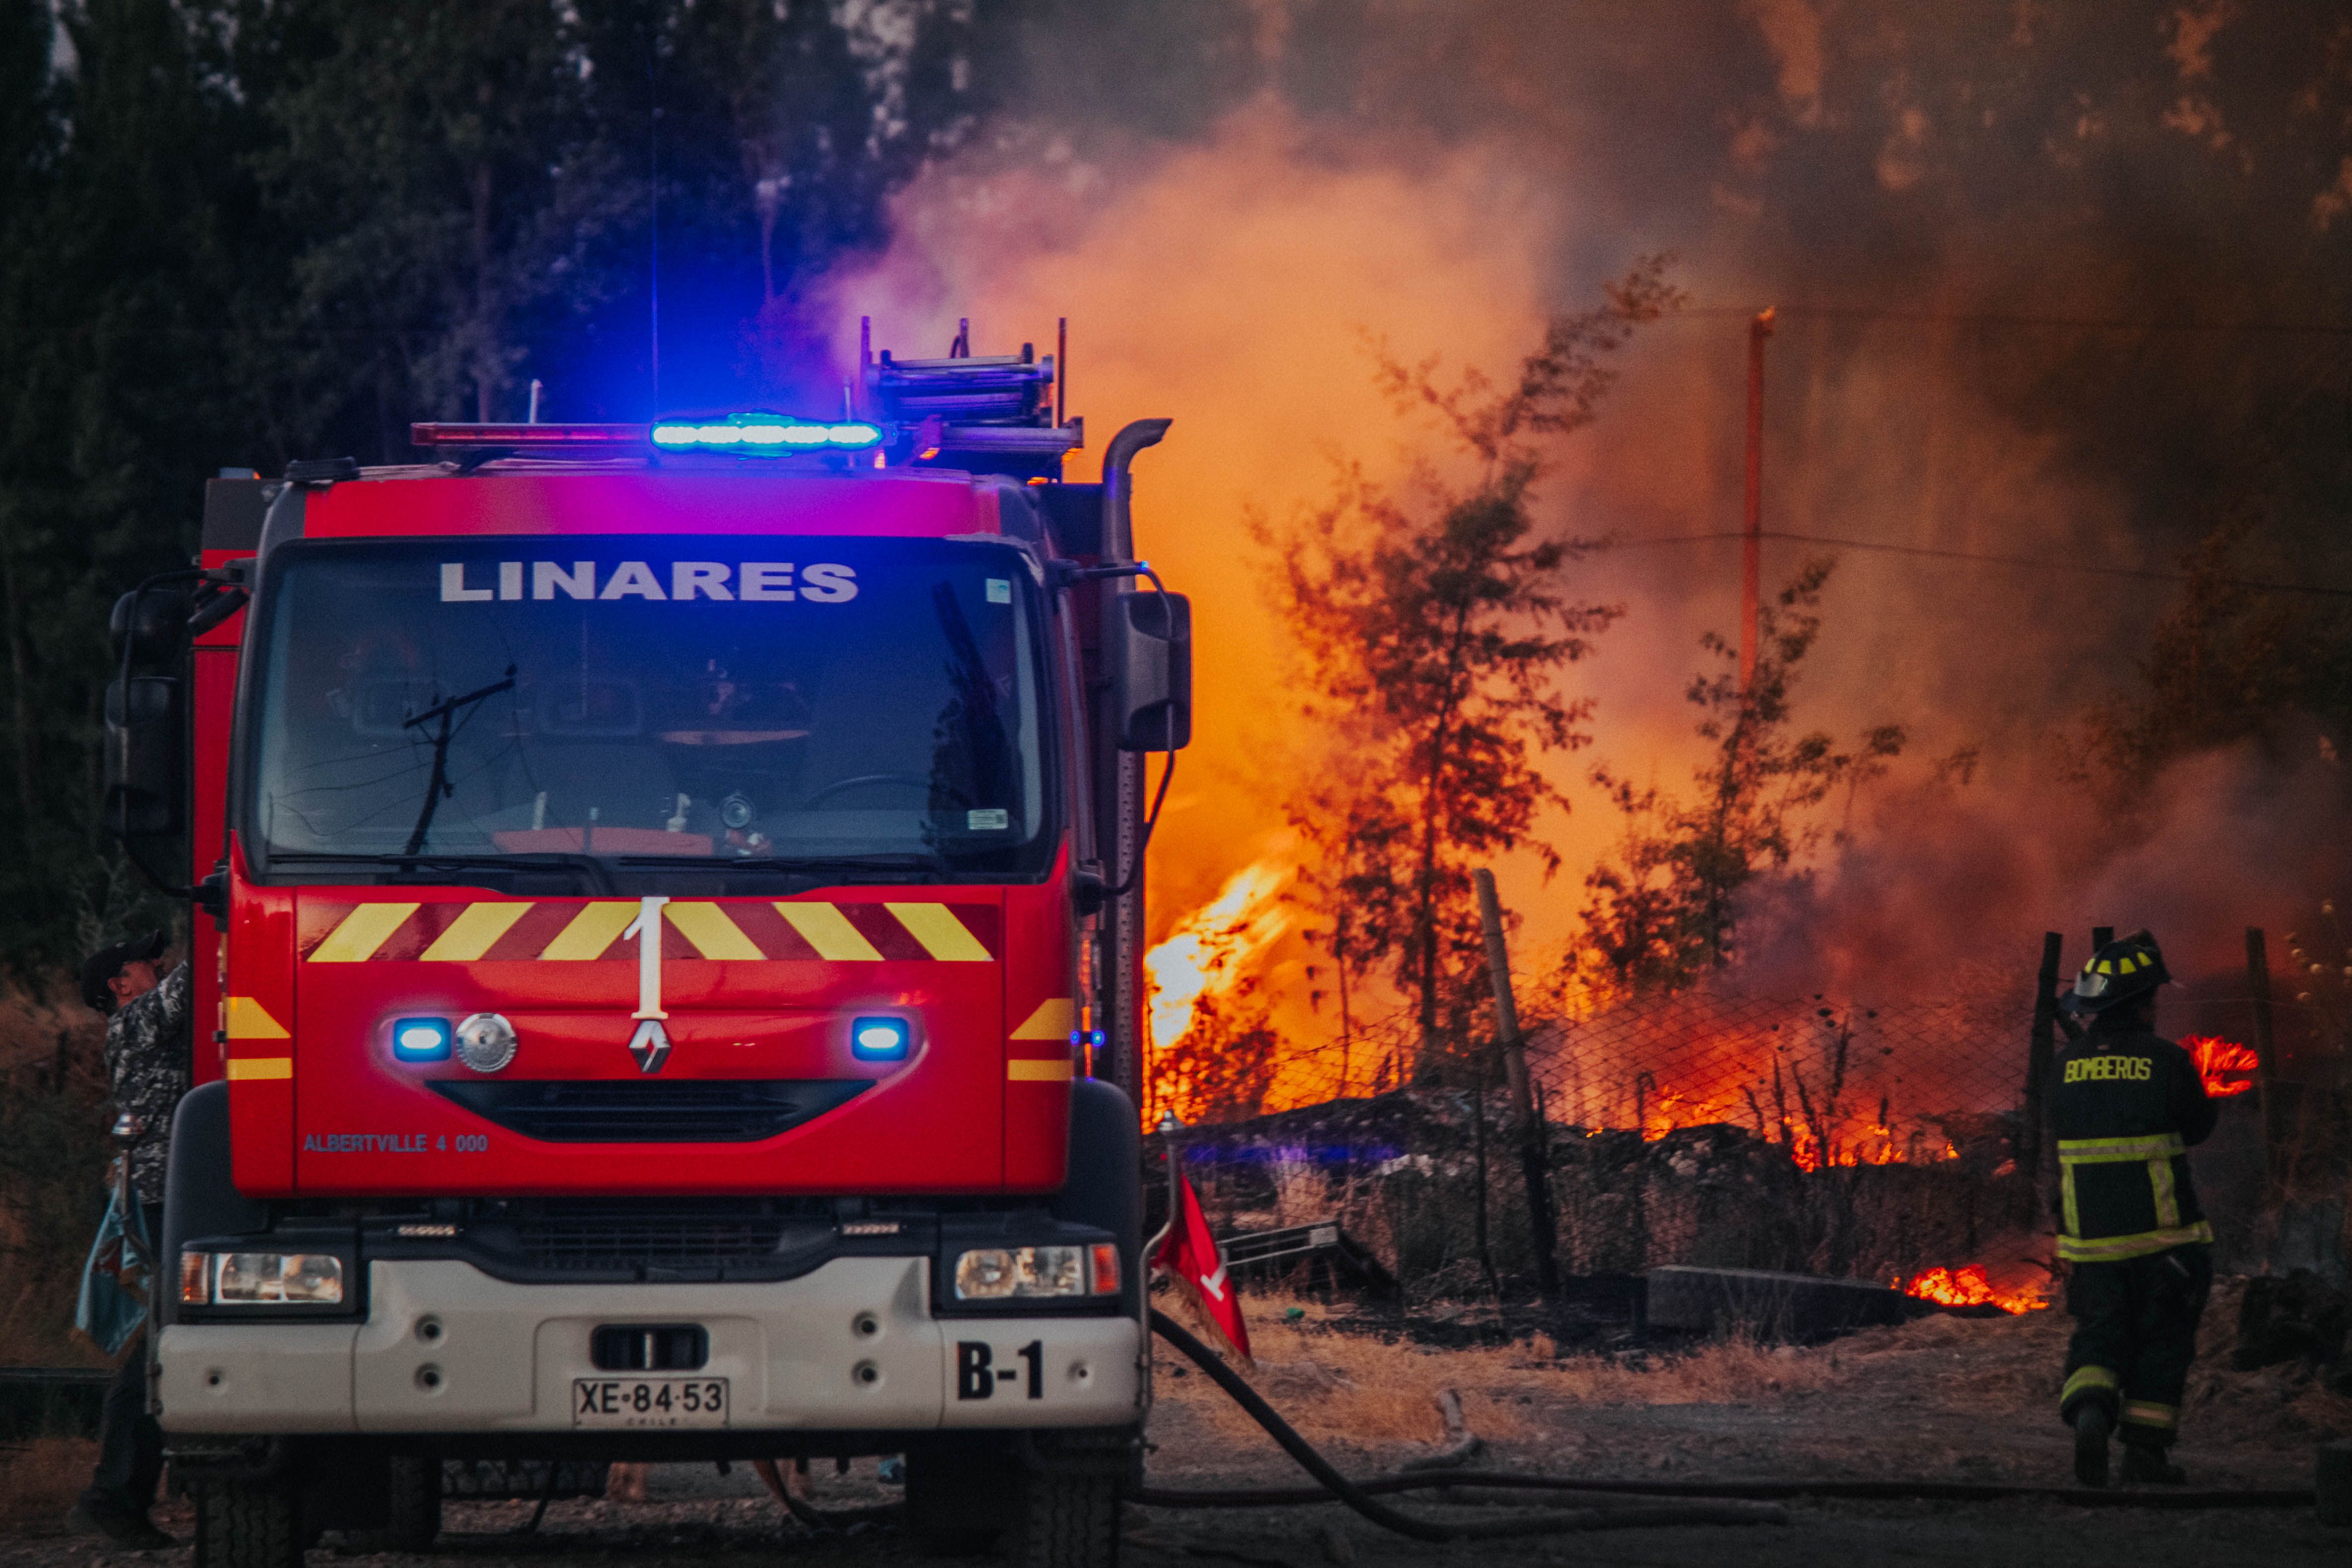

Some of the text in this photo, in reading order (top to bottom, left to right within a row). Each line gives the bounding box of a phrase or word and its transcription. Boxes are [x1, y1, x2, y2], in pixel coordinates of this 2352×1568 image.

[441, 561, 859, 603] LINARES
[623, 896, 670, 1019] 1
[2064, 1055, 2152, 1083] BOMBEROS
[303, 1134, 489, 1152] ALBERTVILLE 4 000
[956, 1340, 1043, 1401] B-1
